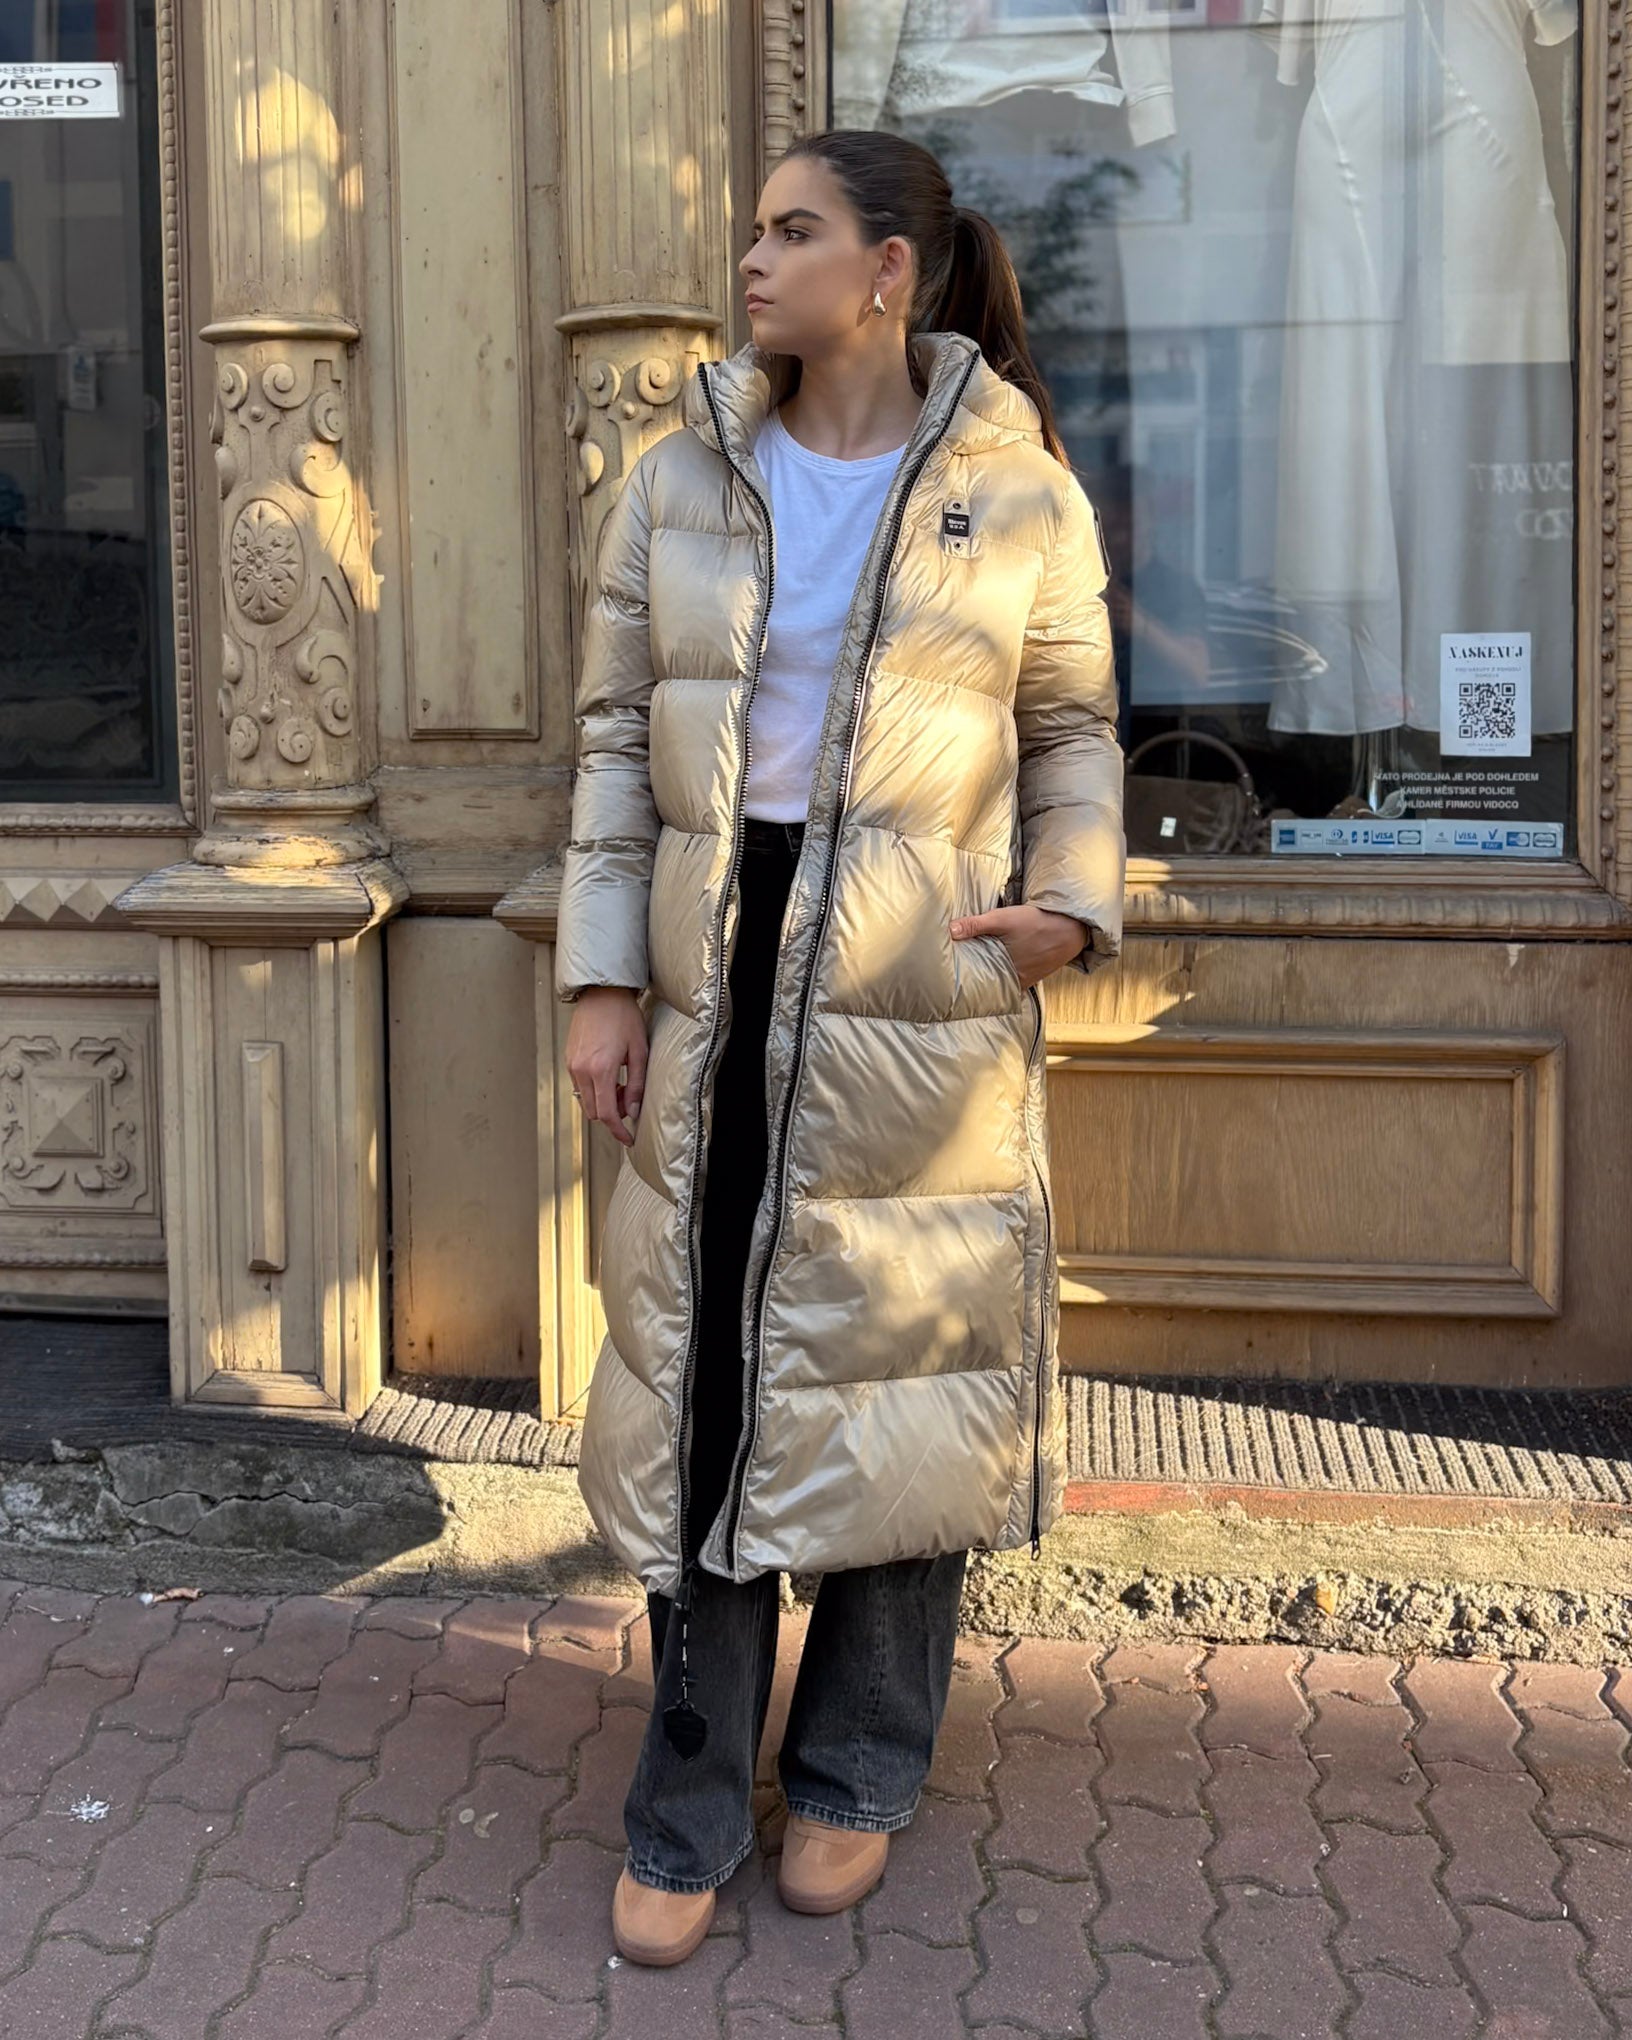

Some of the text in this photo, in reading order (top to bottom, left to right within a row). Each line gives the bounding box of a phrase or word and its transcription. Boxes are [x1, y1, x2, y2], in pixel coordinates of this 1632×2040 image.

[1448, 646, 1523, 659] NASKENUJ
[1402, 772, 1450, 781] PRODEJNA
[1452, 772, 1464, 781] JE
[1466, 772, 1485, 781] POD
[1487, 772, 1539, 781] DOHLEDEM
[1400, 786, 1433, 795] KAMER
[1479, 786, 1515, 795] POLICIE
[1446, 800, 1480, 809] FIRMOU
[1375, 831, 1394, 839] VISA
[1458, 832, 1478, 840] VISA
